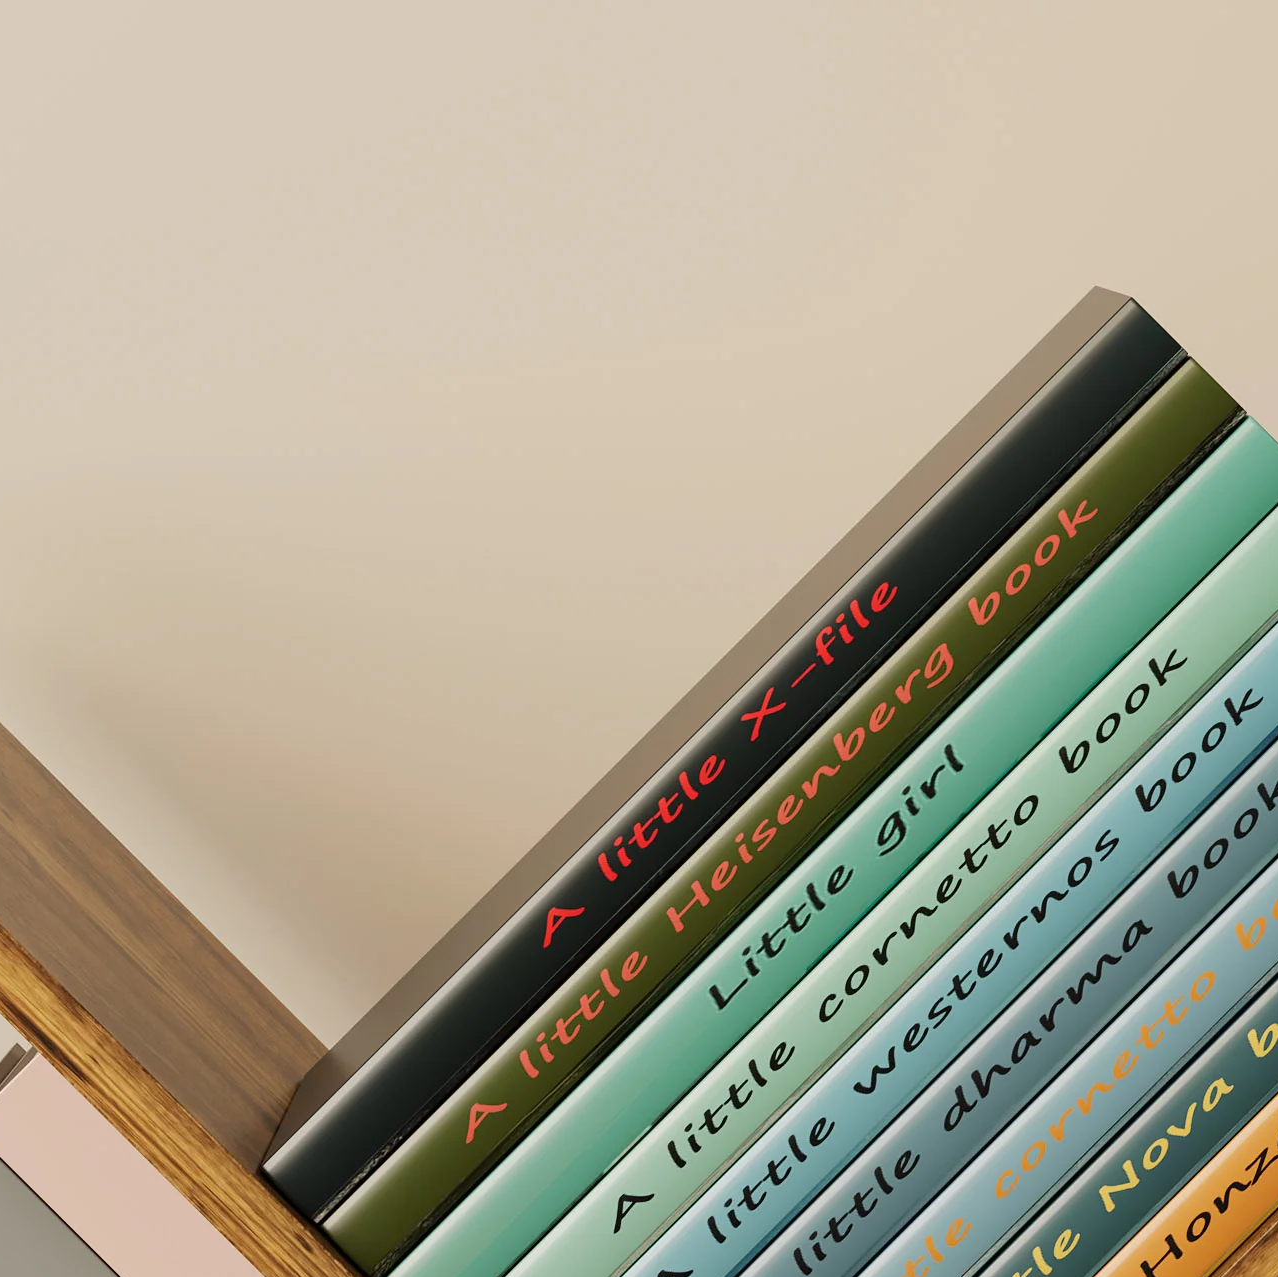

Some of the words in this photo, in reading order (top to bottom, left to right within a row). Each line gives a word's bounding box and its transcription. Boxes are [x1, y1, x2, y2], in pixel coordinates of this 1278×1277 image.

[466, 1102, 508, 1143] A
[520, 950, 648, 1078] little
[667, 643, 954, 932] Heisenberg
[969, 500, 1099, 625] book
[543, 906, 586, 948] A
[598, 754, 727, 882] little
[741, 581, 898, 742] X-file
[614, 1193, 655, 1234] A
[668, 1041, 796, 1168] little
[819, 794, 1039, 1022] cornetto
[1059, 648, 1189, 773] book
[709, 864, 854, 1010] Little
[877, 743, 965, 856] girl
[707, 1117, 836, 1244] little
[853, 829, 1120, 1094] westernos
[1135, 688, 1265, 812] book
[794, 1149, 921, 1276] little
[944, 919, 1154, 1131] dharma
[996, 971, 1216, 1198] cornetto
[1099, 1077, 1235, 1212] Nova
